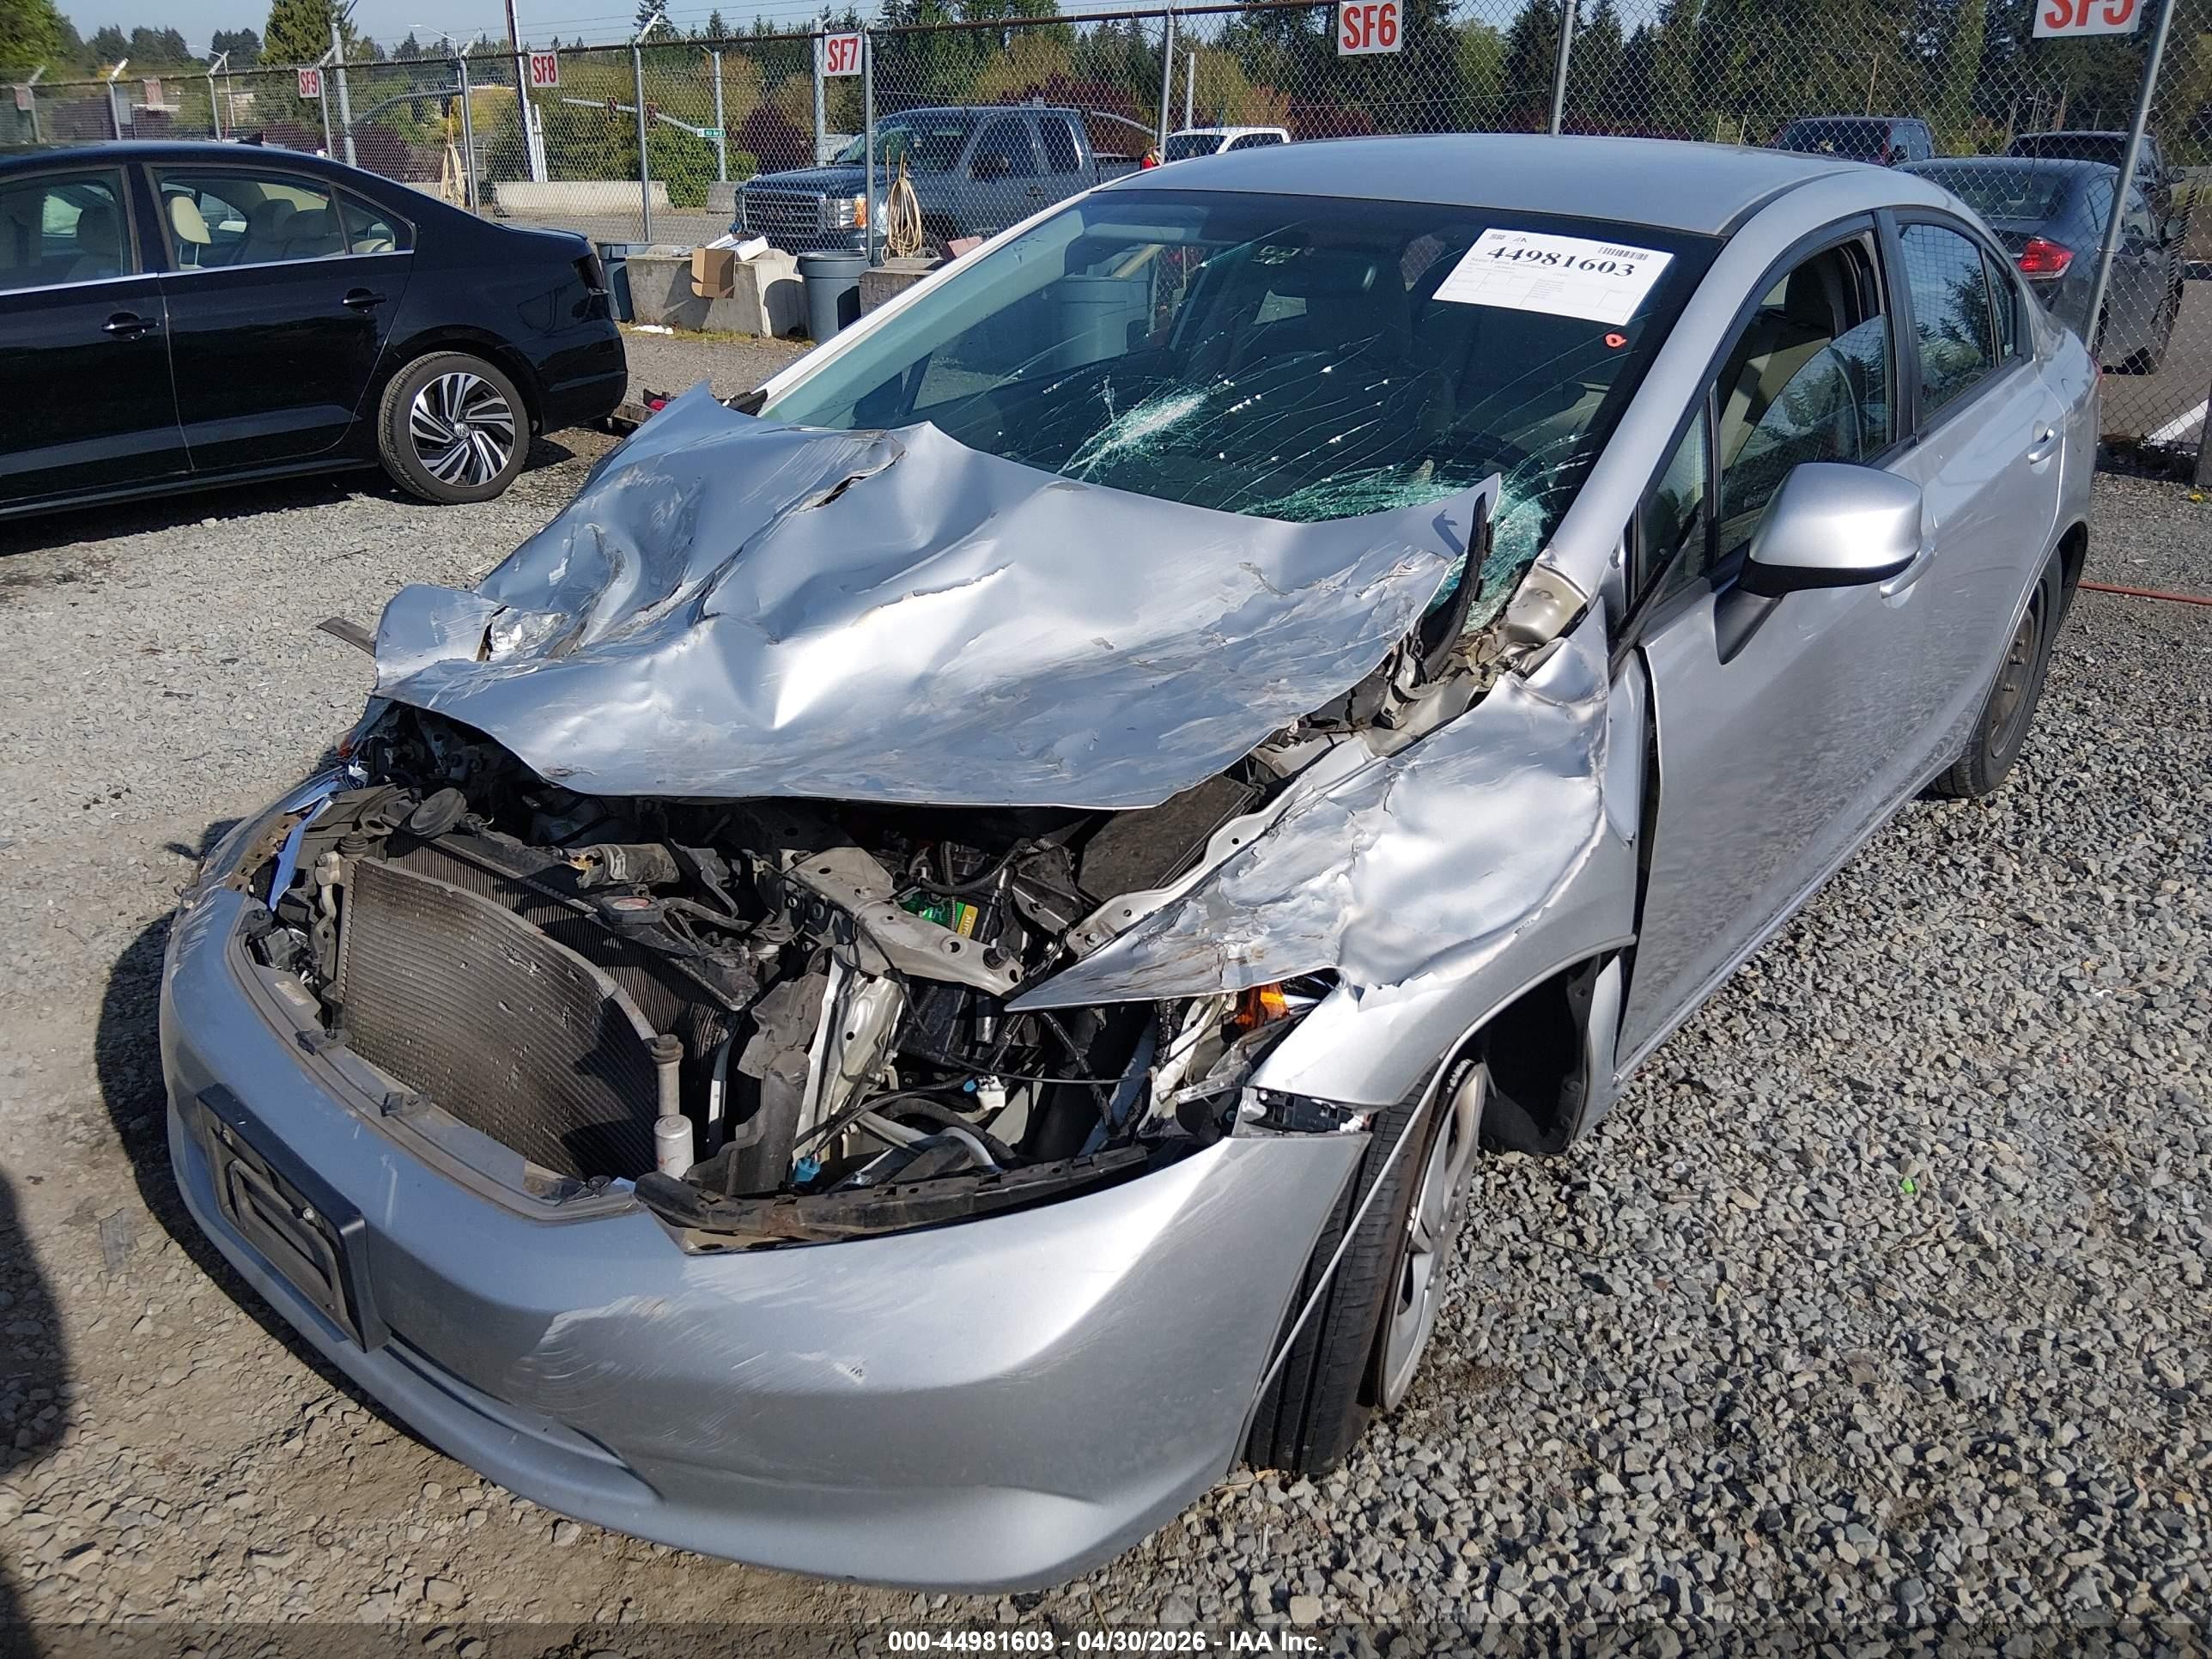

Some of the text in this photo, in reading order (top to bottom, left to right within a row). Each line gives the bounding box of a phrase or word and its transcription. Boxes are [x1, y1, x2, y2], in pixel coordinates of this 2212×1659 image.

[1343, 3, 1397, 49] SF6
[532, 55, 556, 83] SF8
[828, 38, 858, 72] SF7
[301, 70, 317, 94] SF9
[1487, 246, 1635, 276] 44981603
